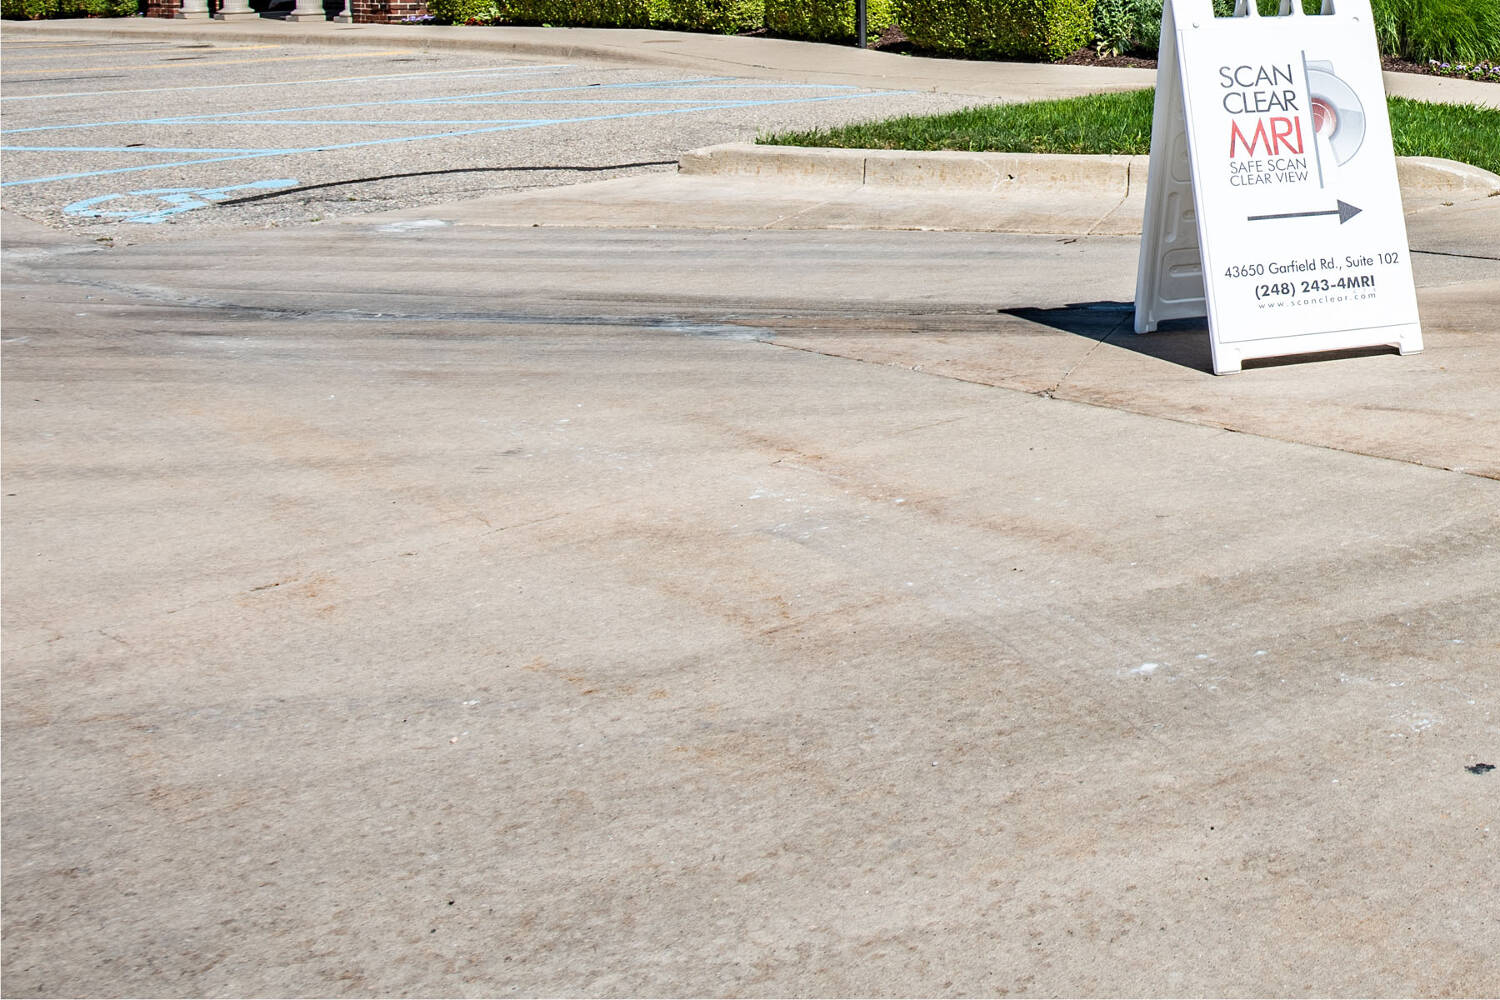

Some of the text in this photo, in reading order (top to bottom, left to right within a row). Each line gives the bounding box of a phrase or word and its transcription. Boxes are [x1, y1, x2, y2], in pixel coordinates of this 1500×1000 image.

[1219, 64, 1293, 88] SCAN
[1223, 90, 1299, 114] CLEAR
[1229, 116, 1304, 158] MRI
[1230, 158, 1307, 174] SAFE SCAN
[1230, 171, 1308, 186] CLEAR VIEW
[1224, 252, 1399, 278] 43650 Garfield Rd., Suite 102
[1255, 275, 1375, 300] (248) 243-4MRI
[1259, 293, 1376, 309] www.scanclear.com
